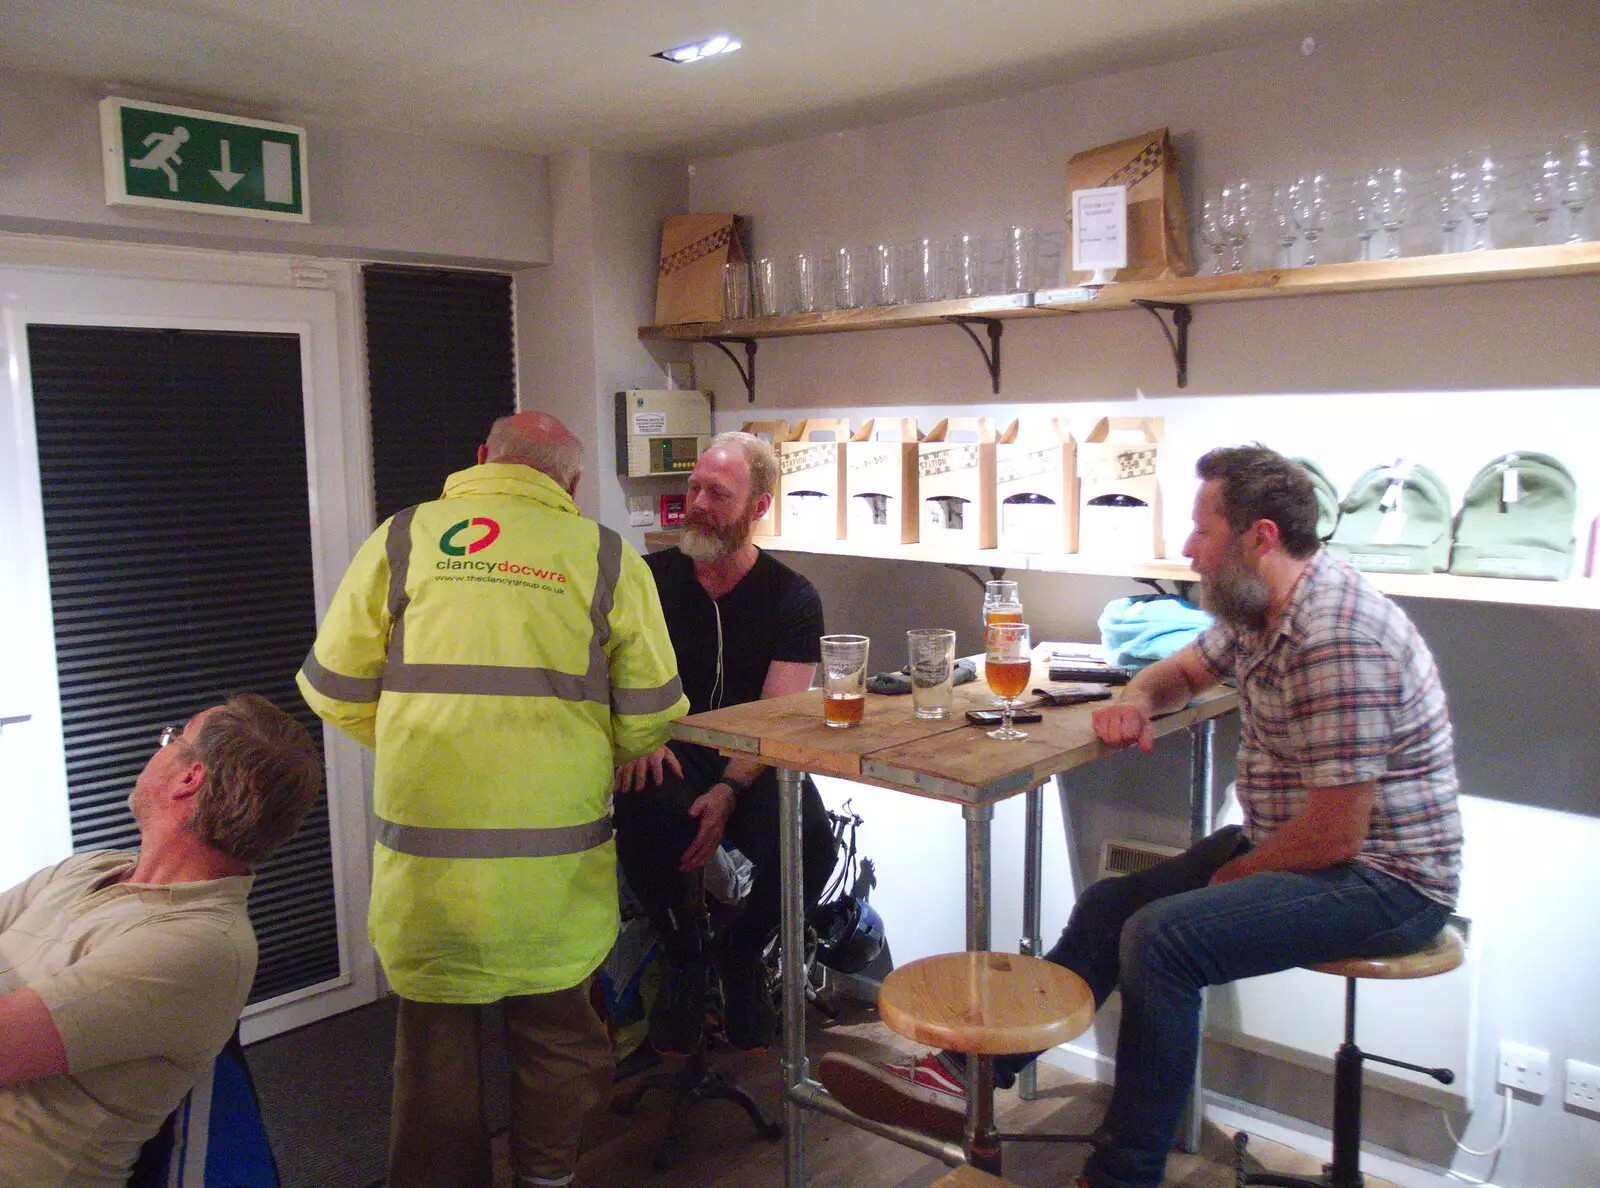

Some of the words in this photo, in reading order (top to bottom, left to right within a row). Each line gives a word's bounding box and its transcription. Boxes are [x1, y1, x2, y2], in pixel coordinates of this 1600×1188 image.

[920, 458, 947, 469] STATION
[436, 558, 567, 583] clancydocwra
[434, 575, 565, 595] www.theclancygroup.co.uk
